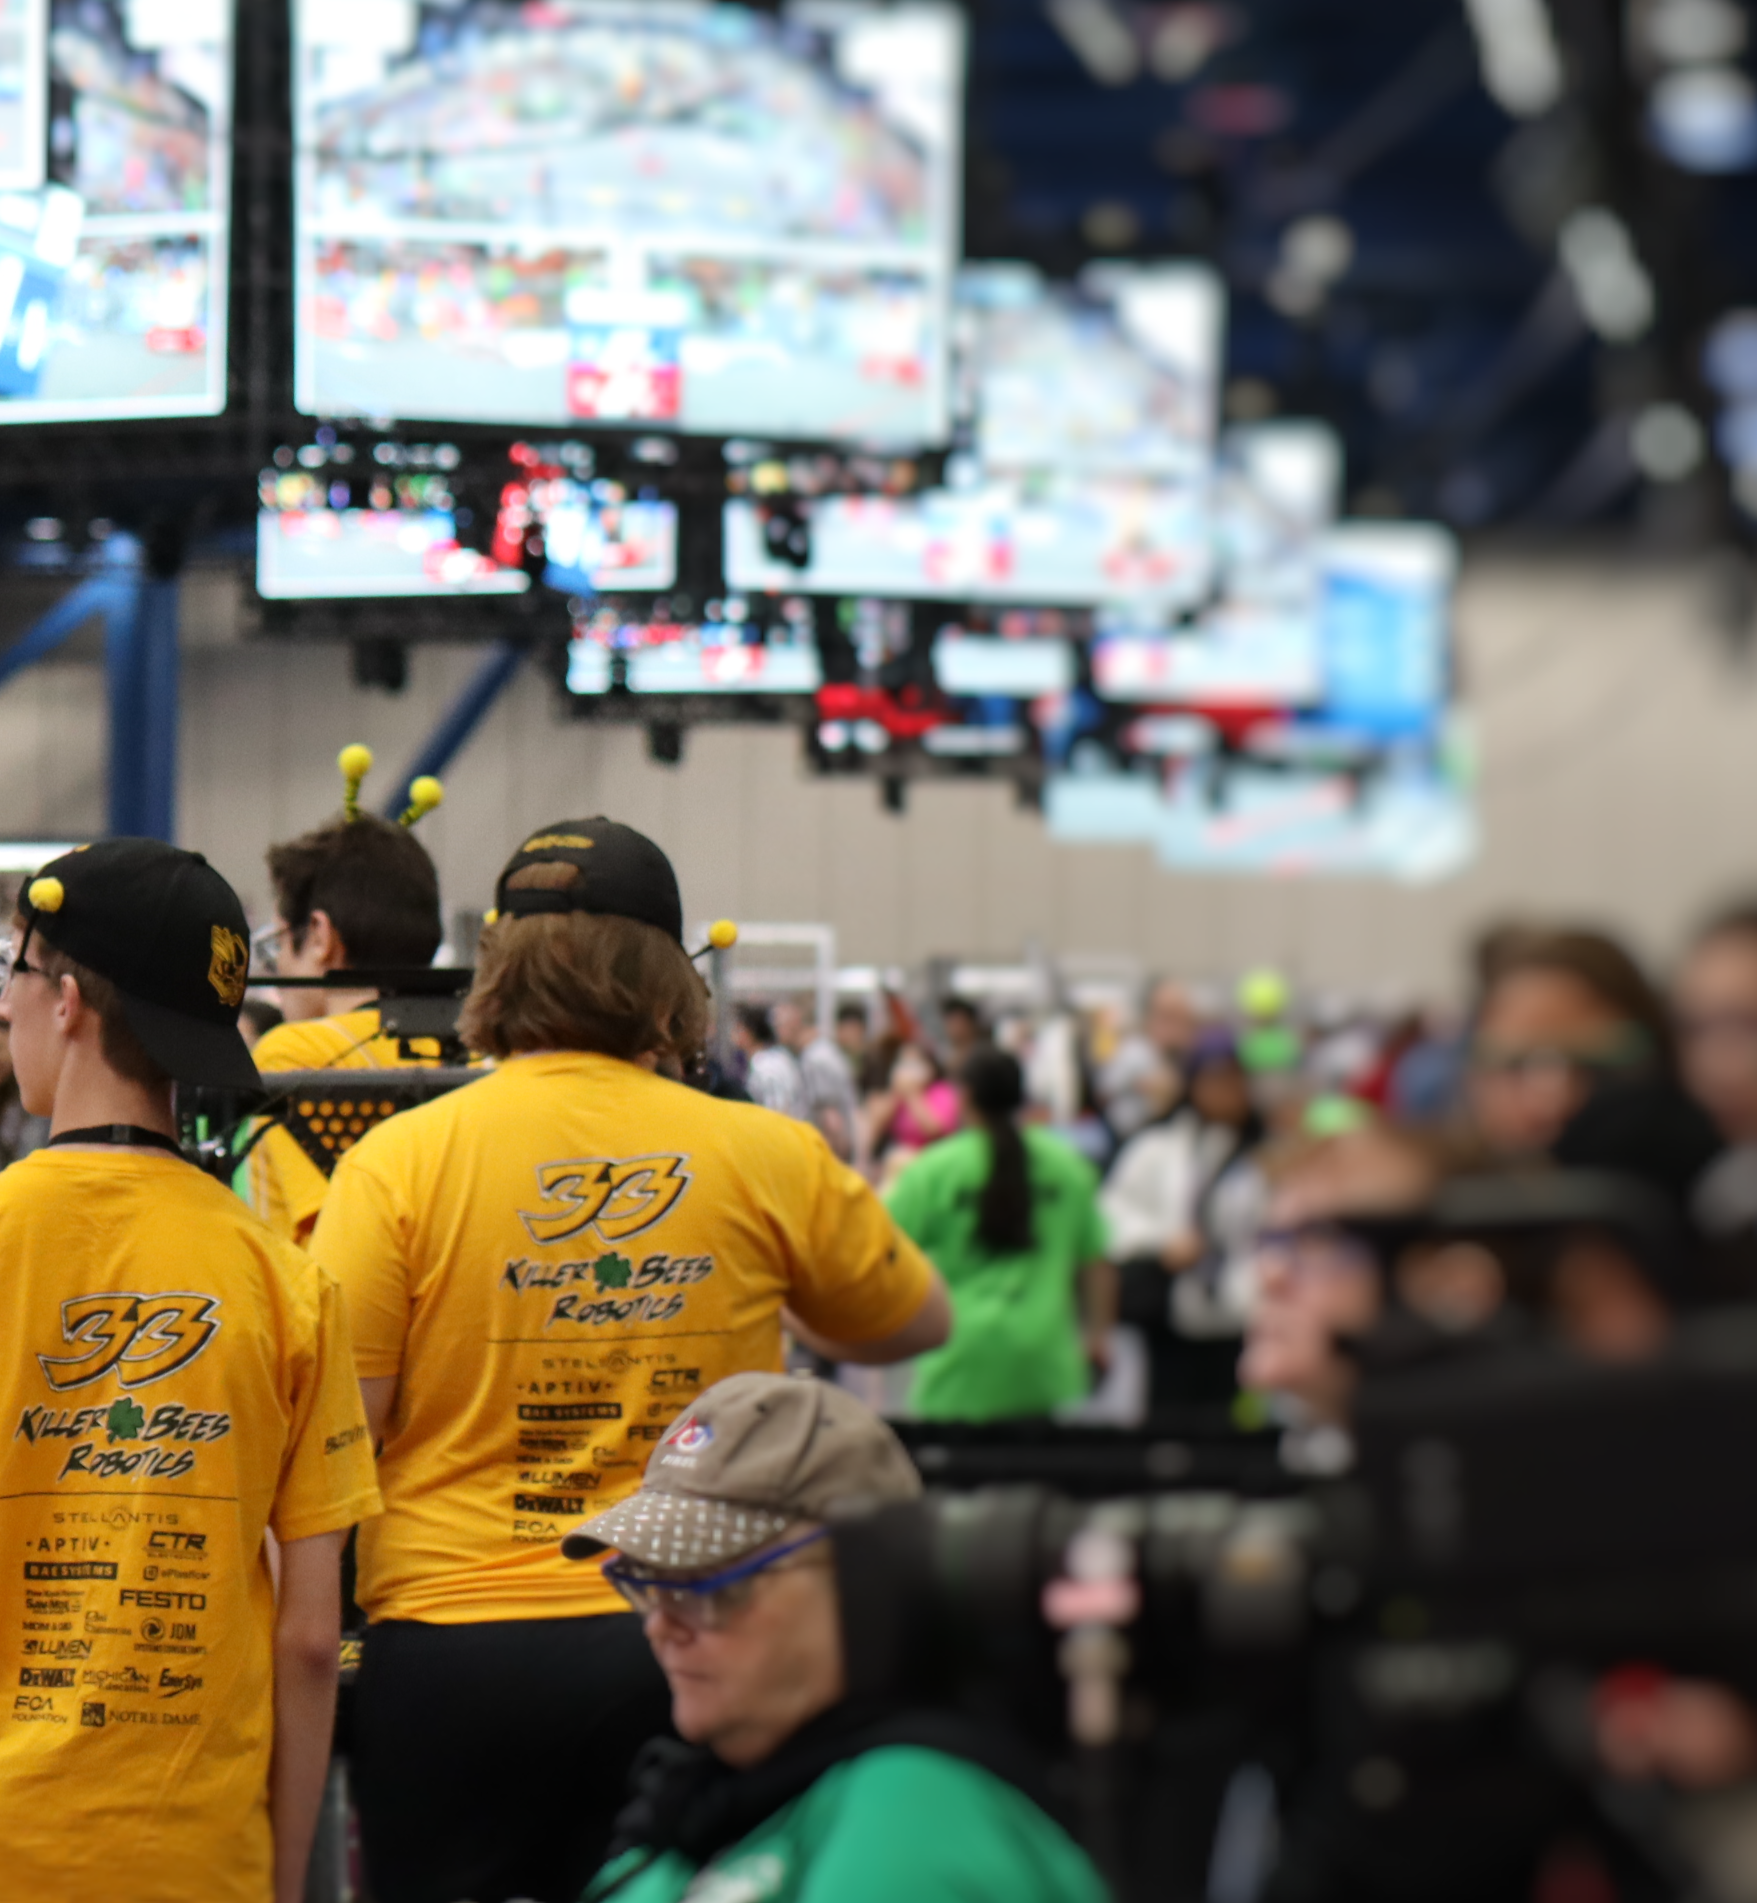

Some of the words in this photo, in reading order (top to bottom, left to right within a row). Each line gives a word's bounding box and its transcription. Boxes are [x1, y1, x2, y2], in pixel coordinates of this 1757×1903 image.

[516, 1153, 695, 1246] 33
[36, 1289, 223, 1393] 33
[652, 1369, 700, 1386] CTR
[53, 1511, 180, 1527] STELLANTIS
[38, 1537, 100, 1551] APTIV
[148, 1530, 207, 1550] CTR
[119, 1589, 207, 1611] FESTO
[14, 1695, 54, 1711] FCA
[109, 1710, 158, 1725] NOTRE
[162, 1712, 202, 1726] DAME
